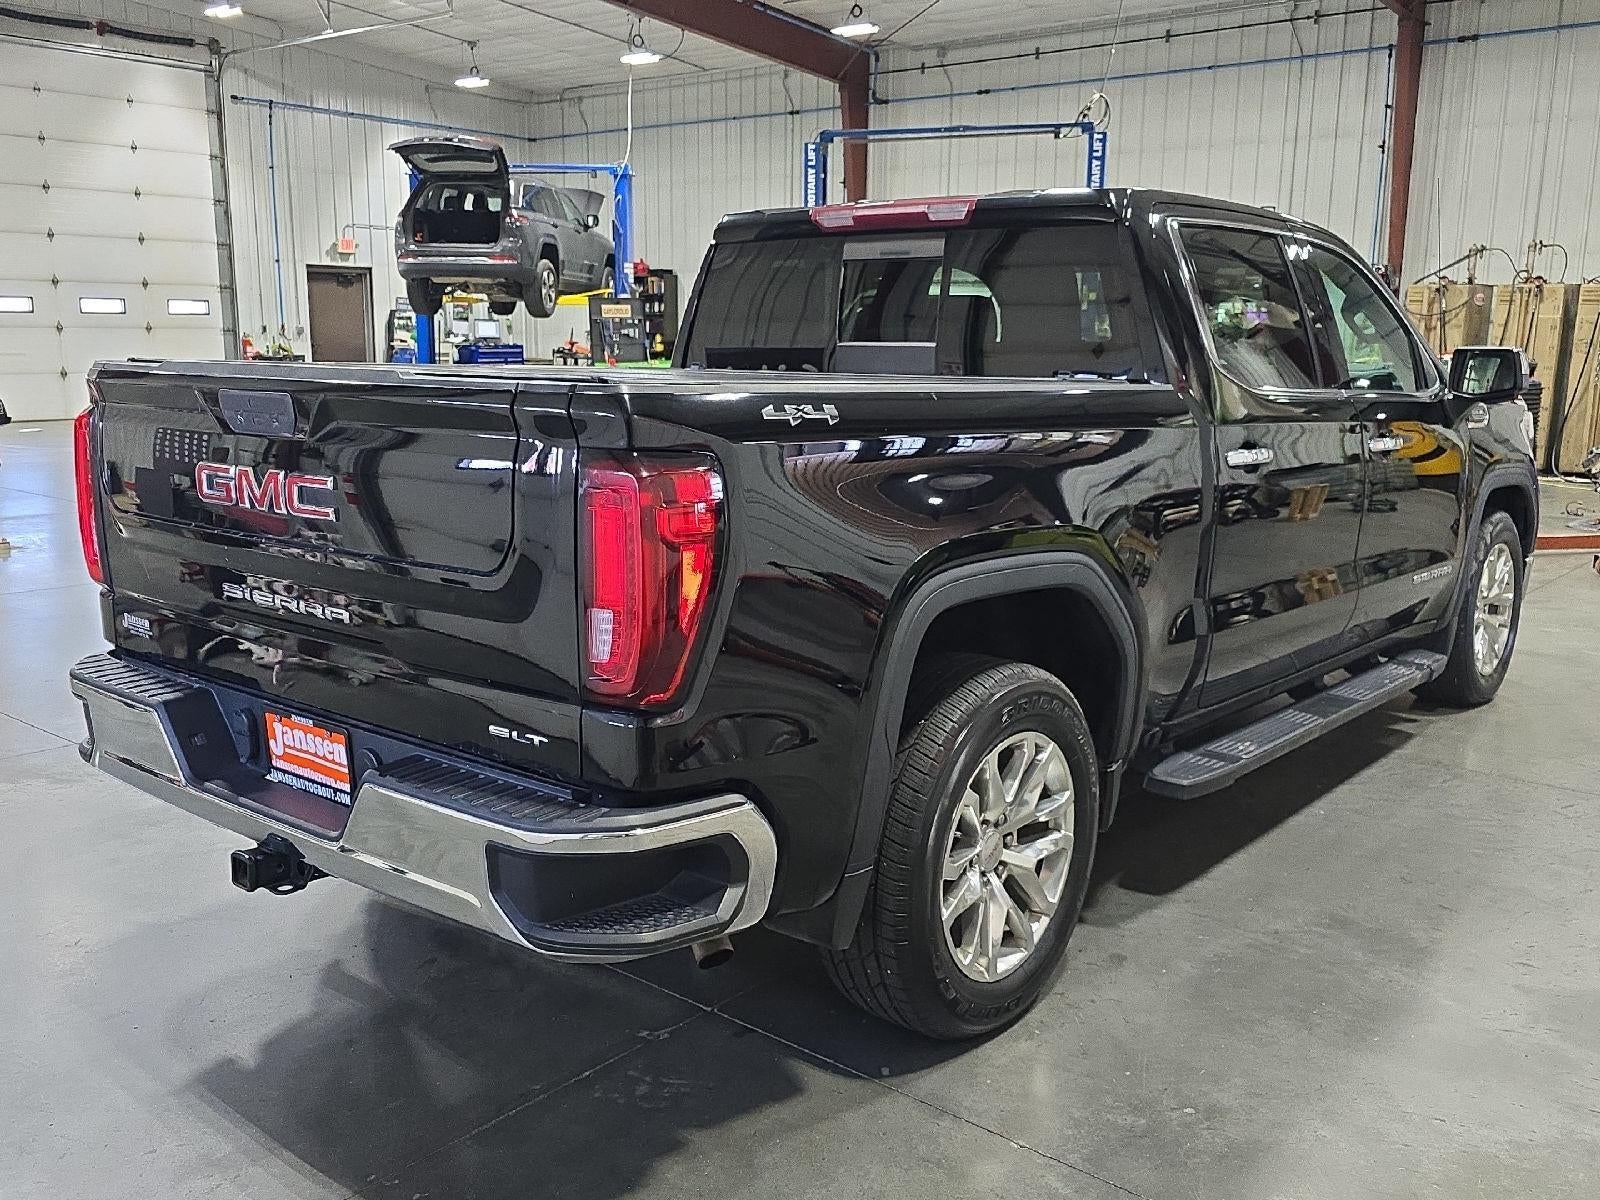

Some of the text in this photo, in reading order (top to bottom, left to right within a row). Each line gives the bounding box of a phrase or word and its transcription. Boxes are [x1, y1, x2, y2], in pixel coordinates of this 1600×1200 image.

[807, 143, 816, 166] LIFT
[1093, 133, 1104, 157] LIFT
[195, 461, 336, 522] GMC
[222, 582, 350, 624] SIERRA
[269, 721, 348, 766] Janssen
[488, 724, 549, 747] SLT
